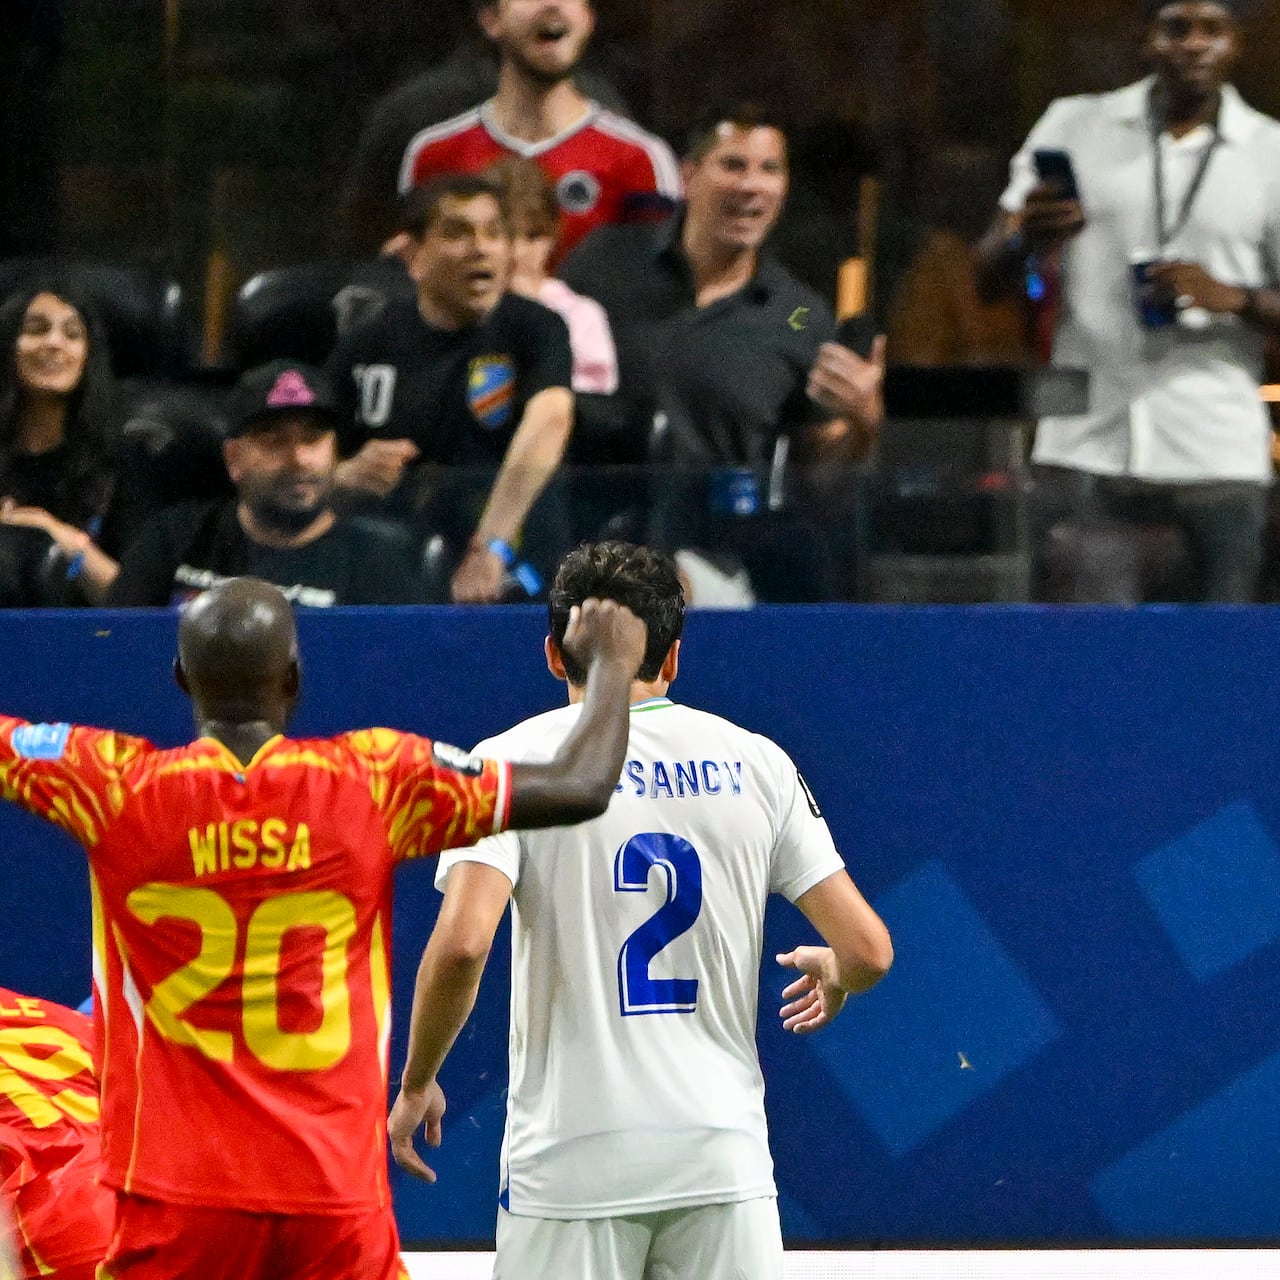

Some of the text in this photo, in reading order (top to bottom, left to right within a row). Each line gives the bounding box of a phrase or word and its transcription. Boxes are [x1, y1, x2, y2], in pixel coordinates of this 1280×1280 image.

[614, 759, 742, 799] SANOV
[188, 818, 312, 877] WISSA
[126, 881, 357, 1072] 20
[613, 832, 703, 1017] 2
